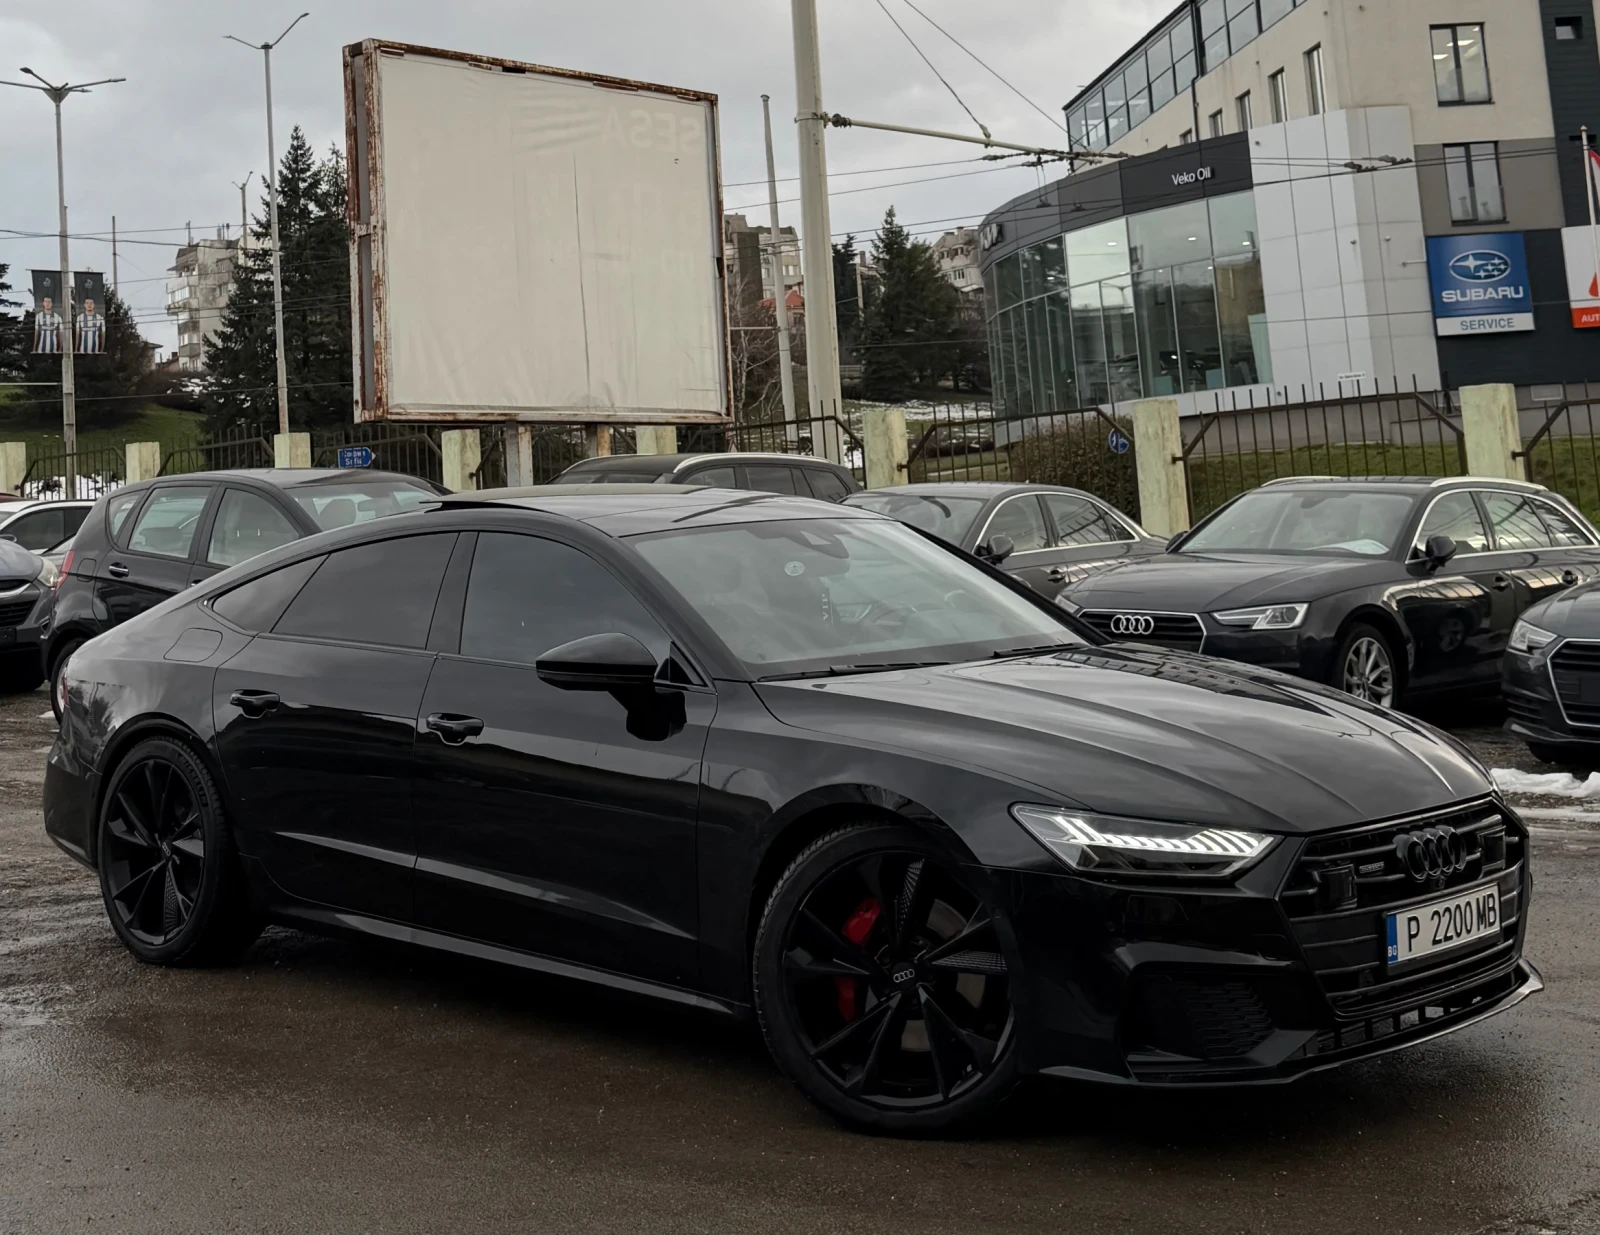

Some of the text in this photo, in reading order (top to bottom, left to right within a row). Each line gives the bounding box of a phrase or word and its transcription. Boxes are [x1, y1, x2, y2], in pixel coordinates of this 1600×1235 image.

[1171, 166, 1211, 185] Veko Oil
[1442, 286, 1523, 303] SUBARU
[1460, 318, 1514, 331] SERVICE
[1407, 893, 1498, 952] P 2200 MB
[1388, 945, 1398, 957] BG
